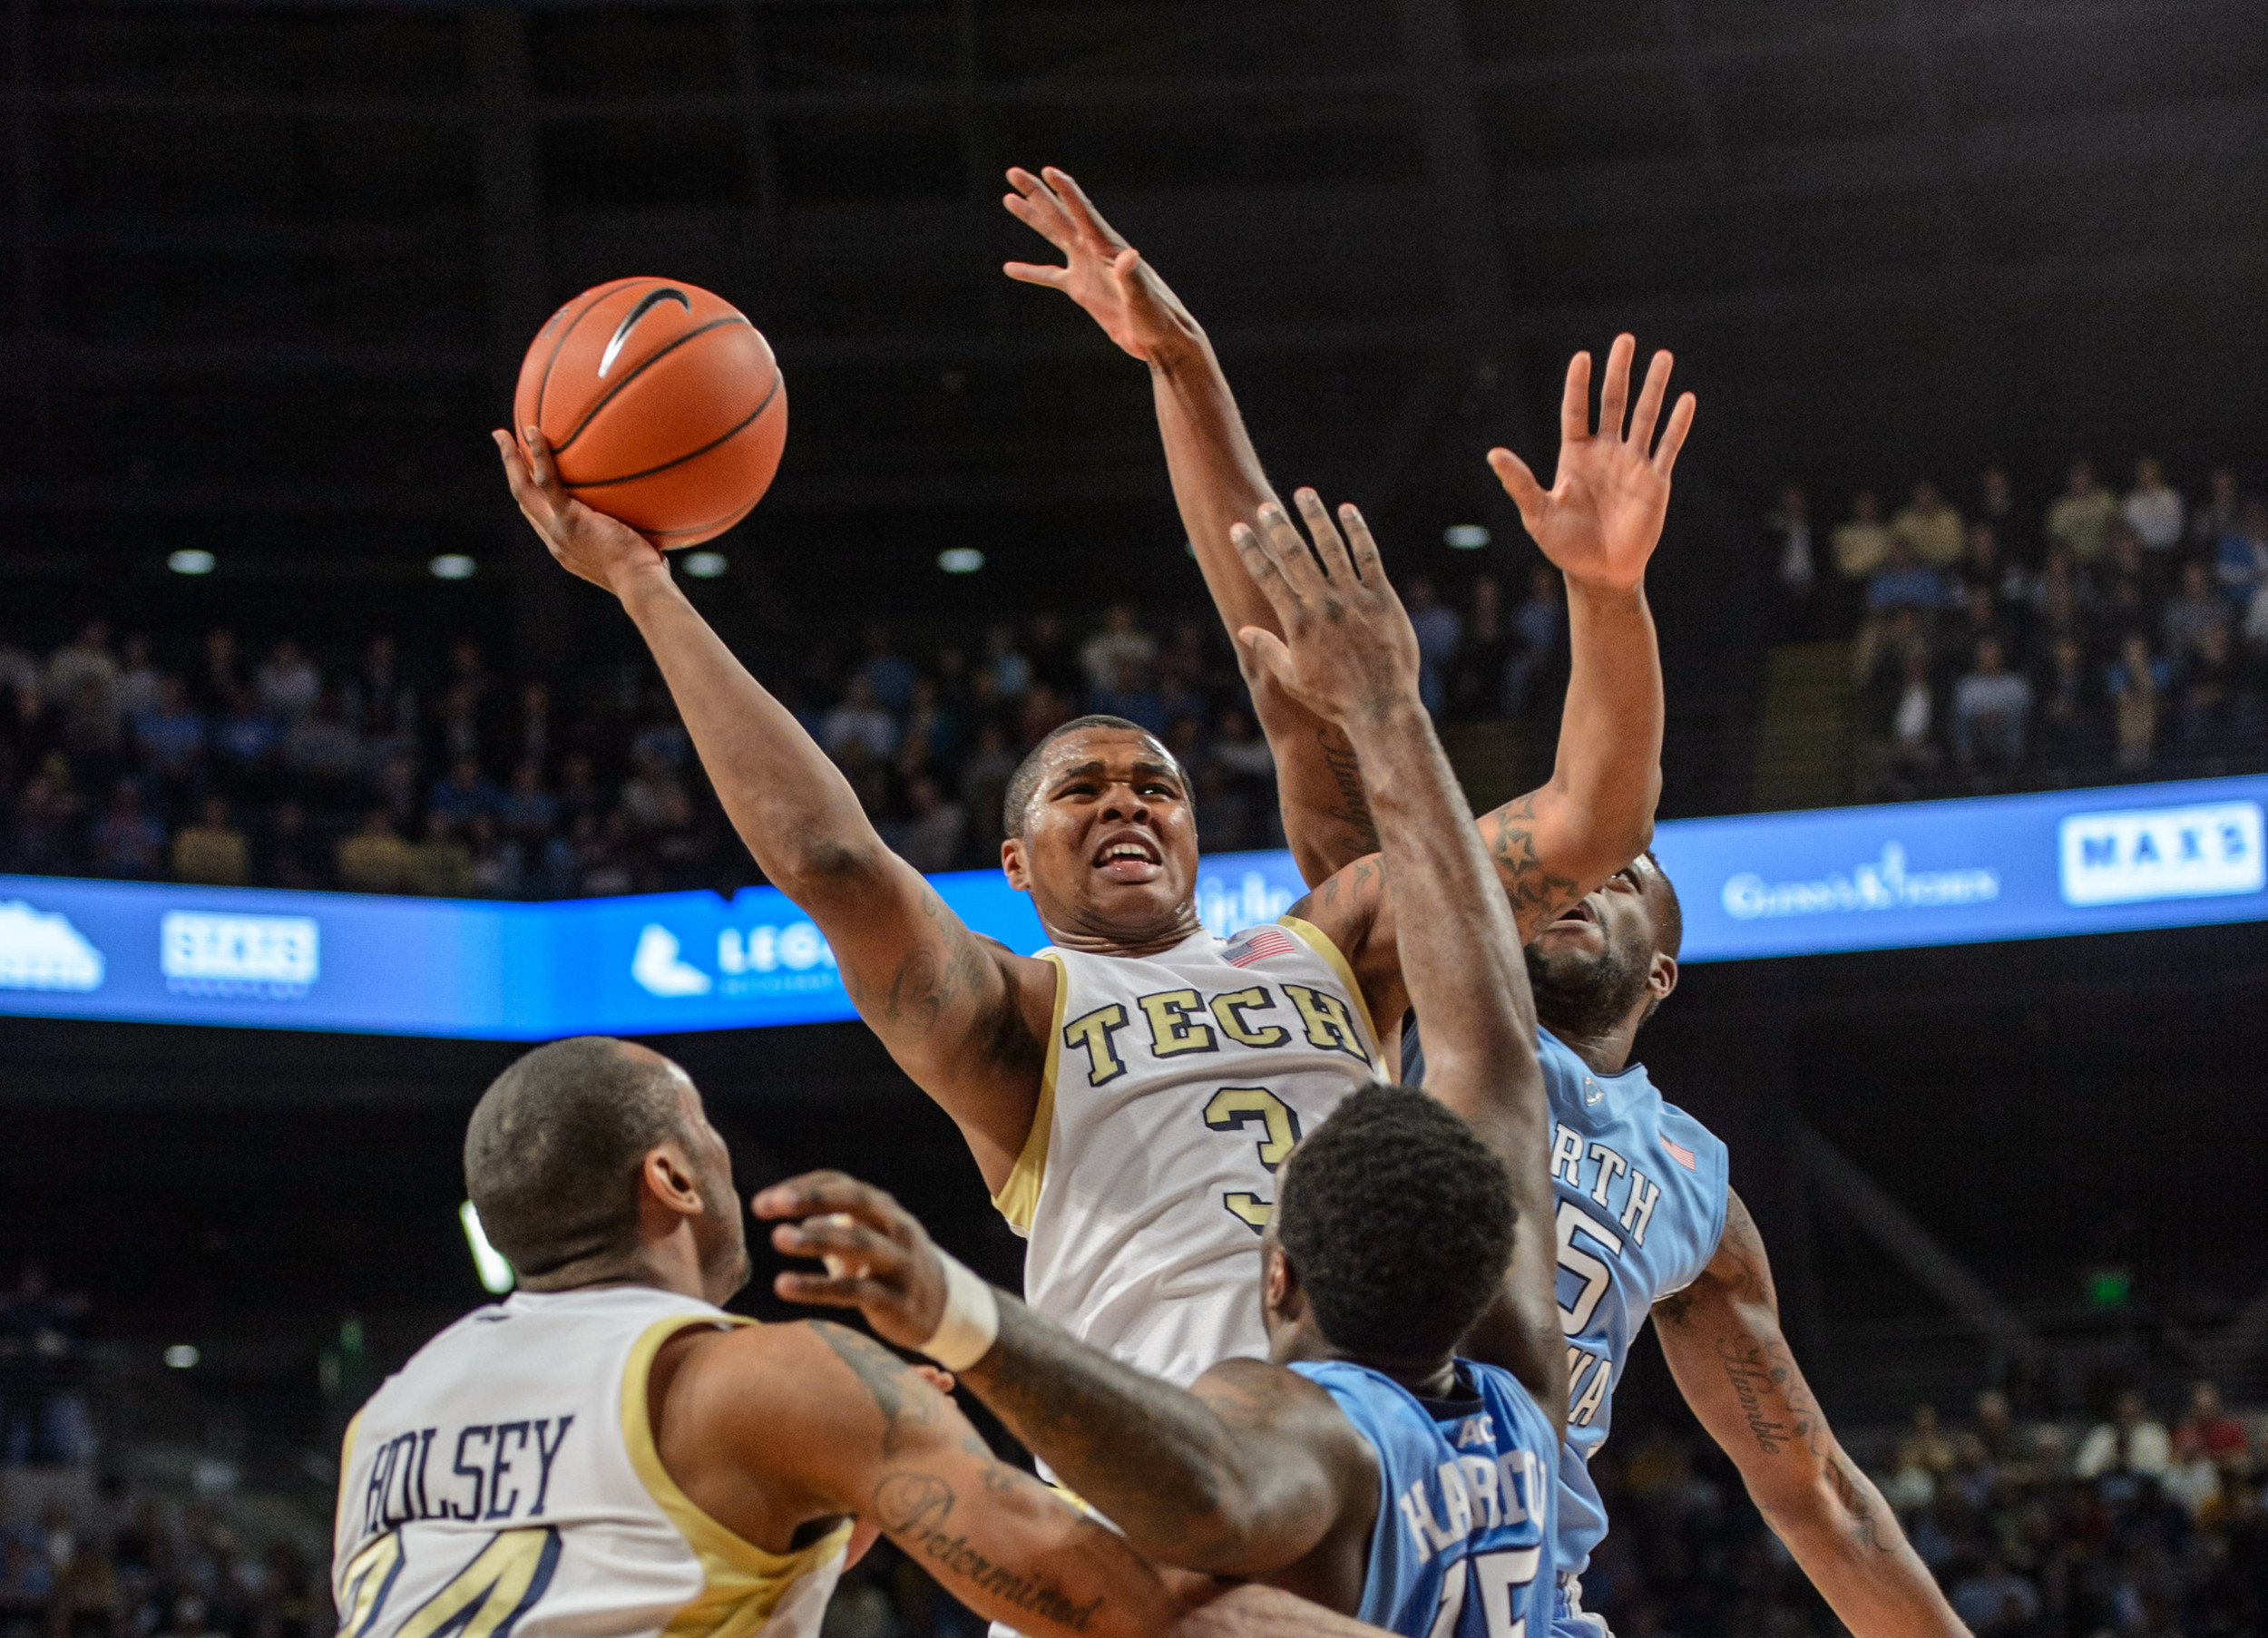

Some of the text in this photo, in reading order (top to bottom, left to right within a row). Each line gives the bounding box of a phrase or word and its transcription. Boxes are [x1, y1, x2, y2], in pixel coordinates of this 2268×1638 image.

[1062, 983, 1374, 1087] TECH
[1202, 1087, 1302, 1235] 3
[1550, 1122, 1661, 1249] RTH
[1555, 1198, 1623, 1337] 5
[363, 1414, 575, 1536] HOLSEY
[1457, 1416, 1496, 1448] AC
